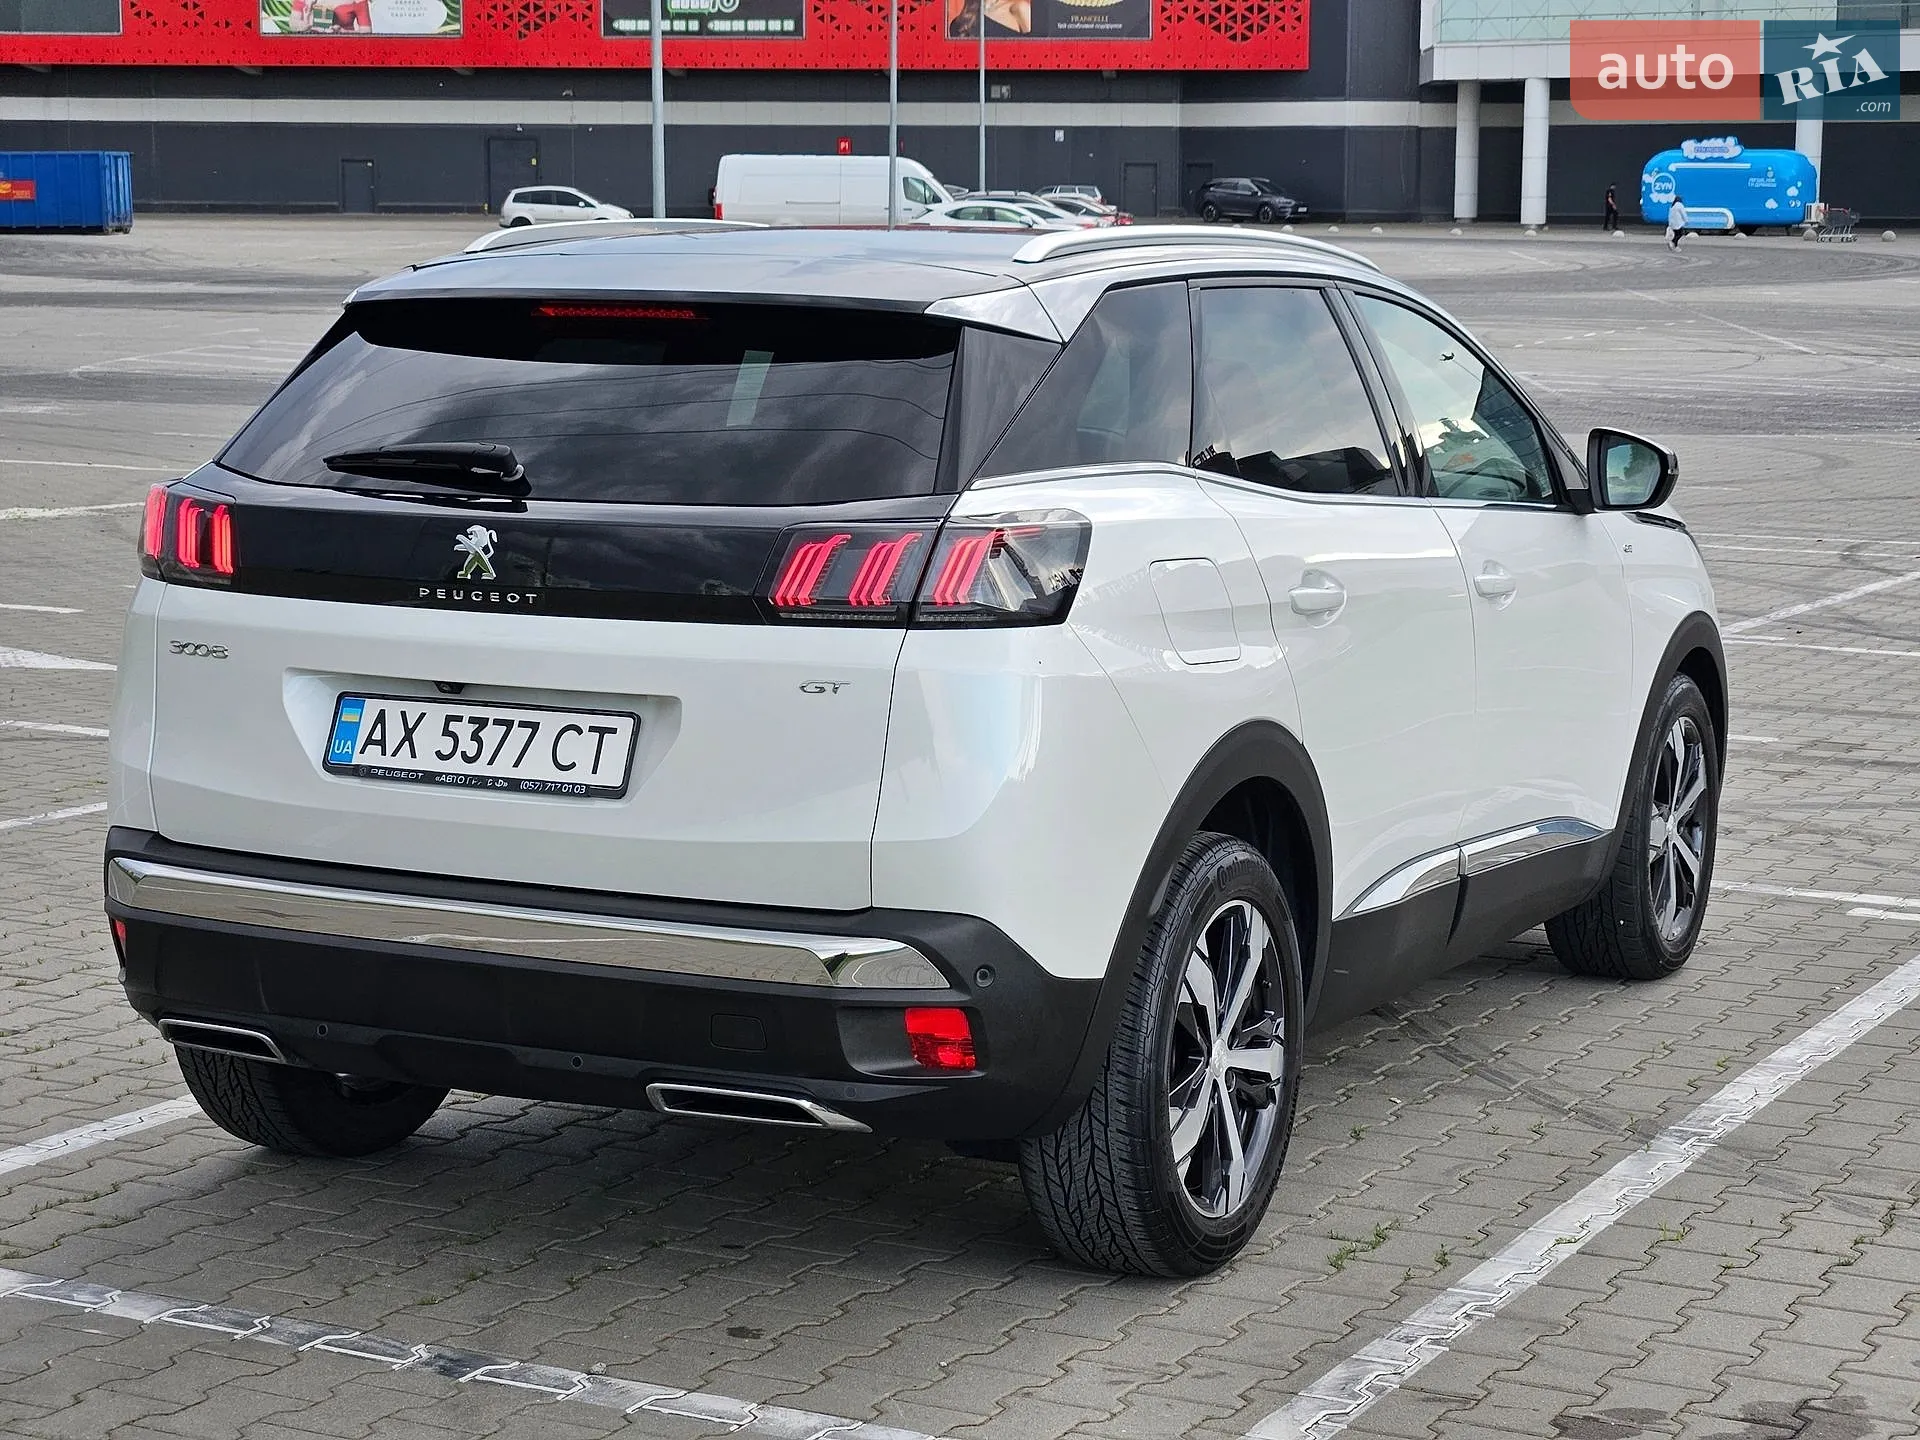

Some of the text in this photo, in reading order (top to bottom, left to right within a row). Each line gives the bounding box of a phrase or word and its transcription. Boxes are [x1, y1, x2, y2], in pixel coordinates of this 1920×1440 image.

[419, 587, 537, 604] PEUGEOT
[168, 639, 230, 659] 3008
[799, 681, 851, 695] GT
[334, 739, 353, 755] UA
[358, 708, 618, 775] AX 5377 CT
[369, 768, 425, 780] PEUGEOT
